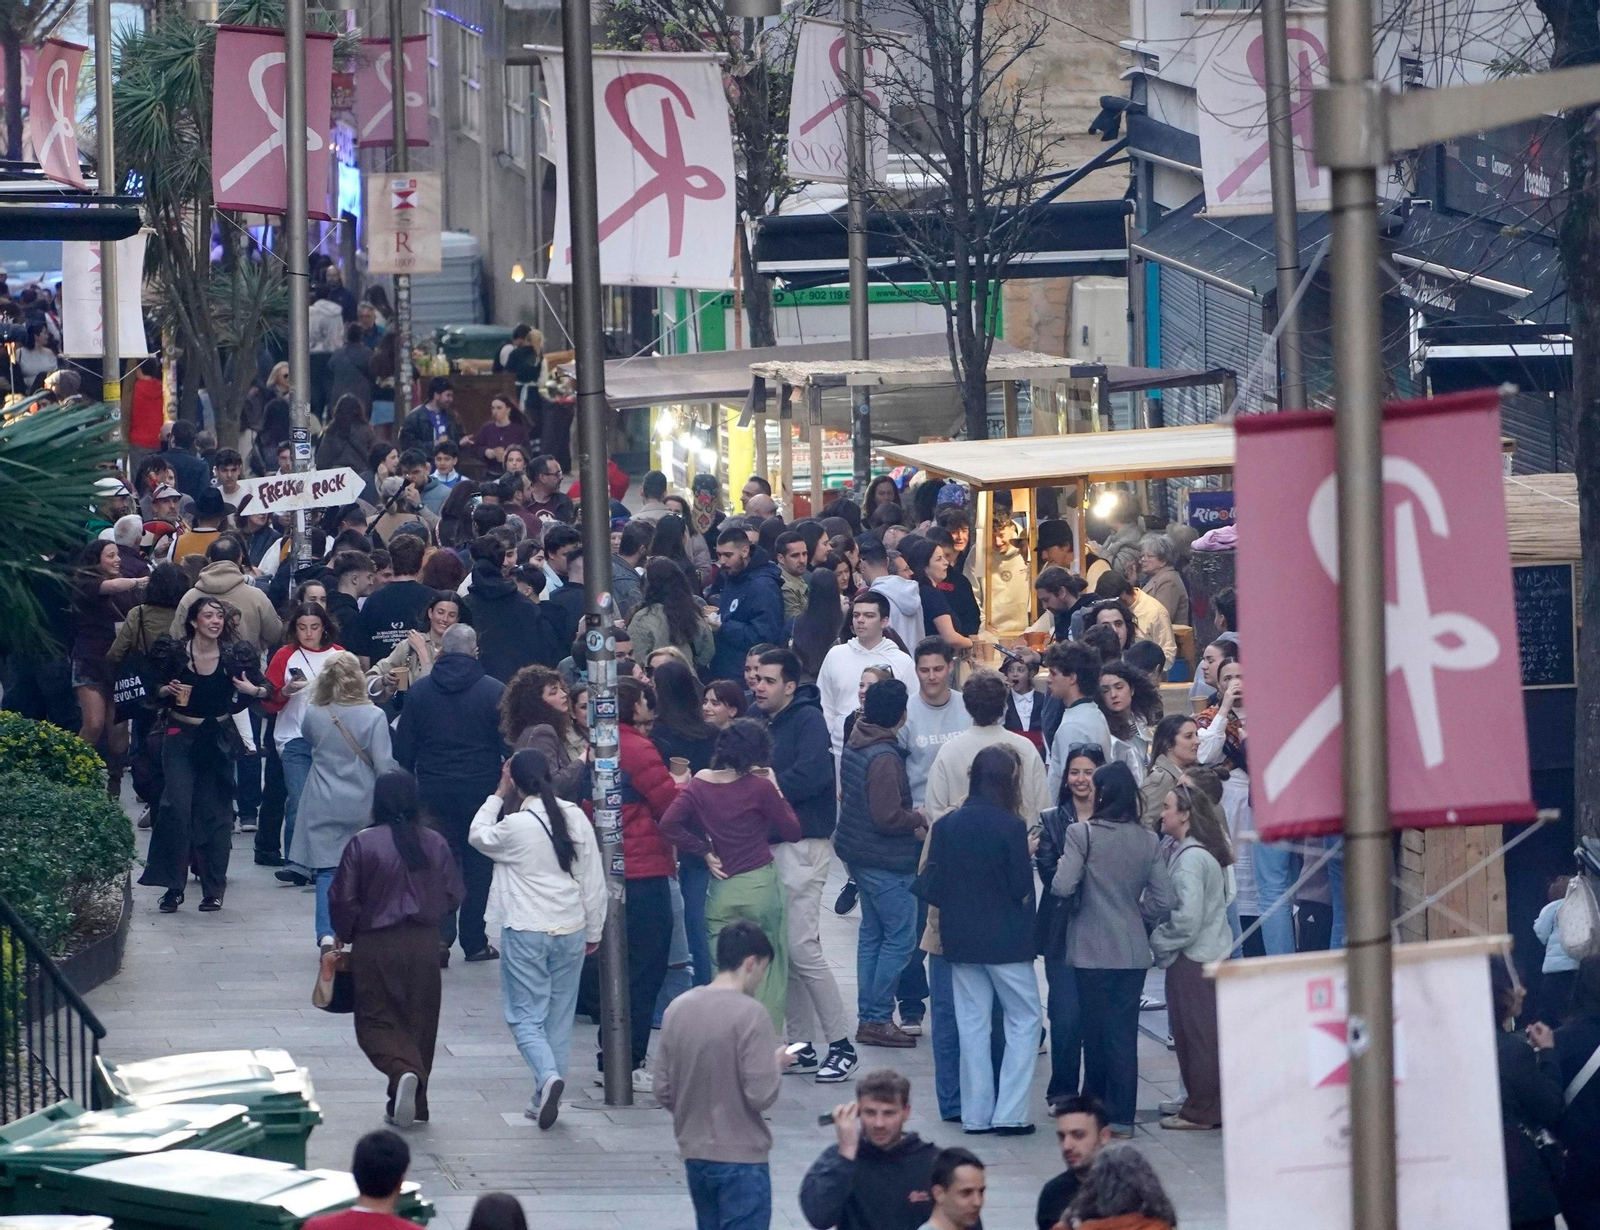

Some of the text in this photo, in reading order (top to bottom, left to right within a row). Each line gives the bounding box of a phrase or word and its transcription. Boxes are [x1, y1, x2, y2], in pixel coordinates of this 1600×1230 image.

[395, 231, 413, 253] R
[809, 290, 827, 300] 902
[829, 289, 843, 299] 119
[311, 473, 346, 500] ROCK
[119, 675, 142, 690] NOSA
